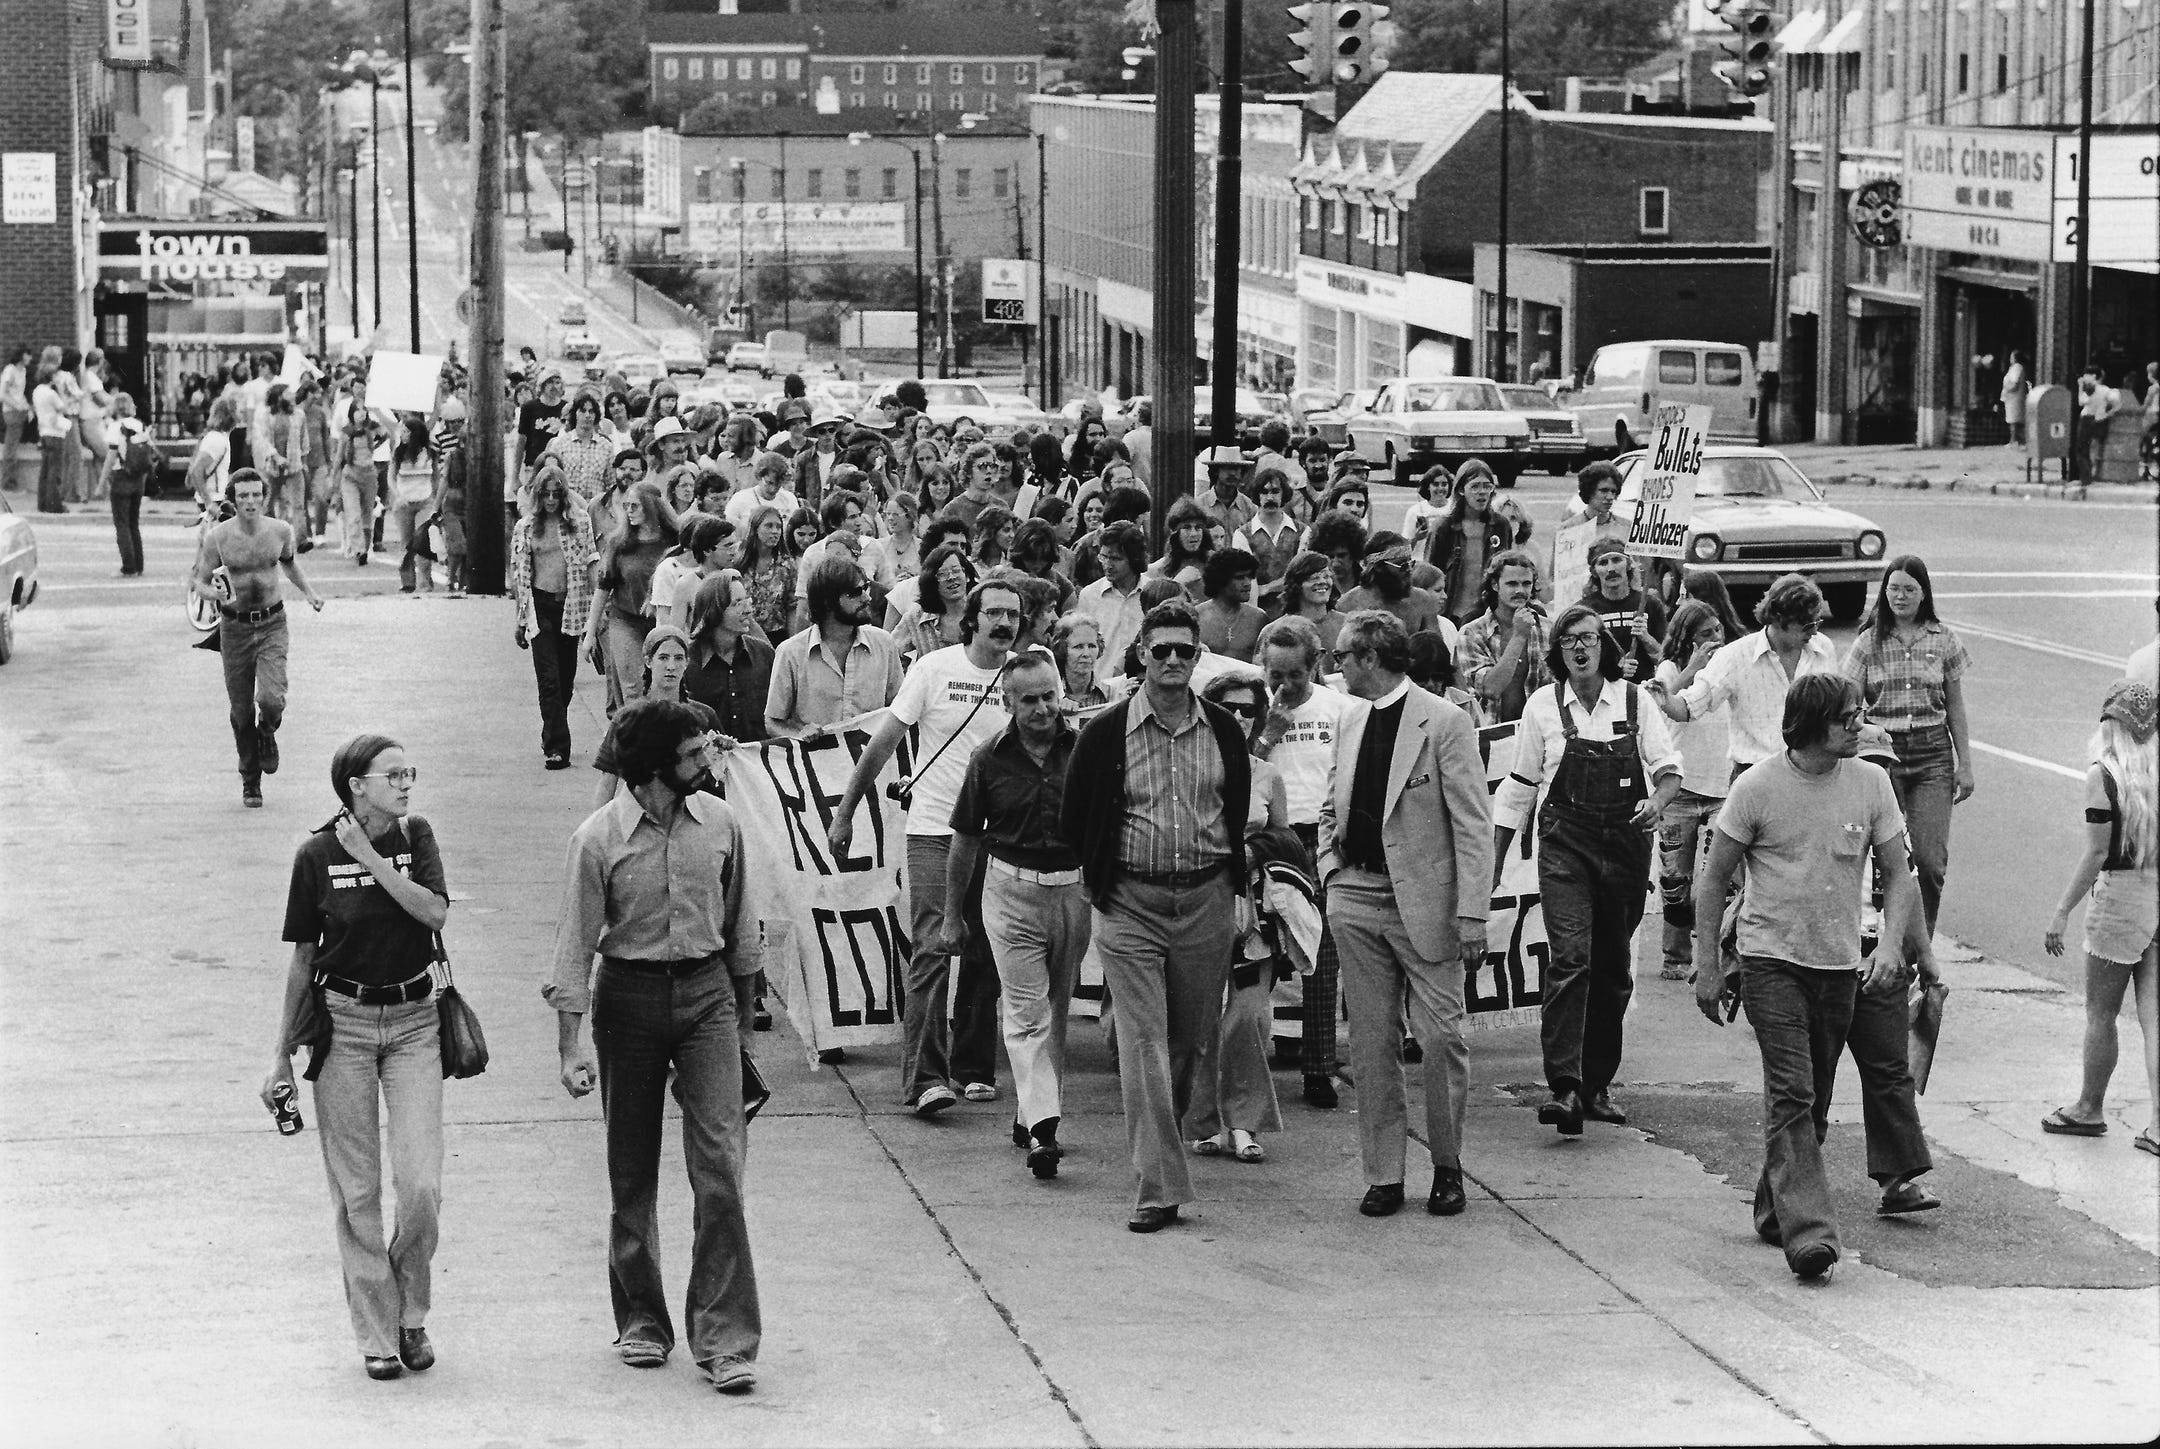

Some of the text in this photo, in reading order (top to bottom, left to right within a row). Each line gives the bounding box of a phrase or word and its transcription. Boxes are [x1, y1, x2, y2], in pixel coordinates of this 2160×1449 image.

[1911, 135, 1954, 175] kent
[1961, 138, 2045, 182] cinemas
[2070, 152, 2077, 181] 1
[12, 191, 44, 200] RENT
[136, 230, 251, 257] town
[2066, 216, 2079, 245] 2
[140, 252, 287, 281] house
[1654, 426, 1703, 475] Bullets
[1628, 500, 1689, 547] Bulldozer
[948, 681, 983, 691] REMEMBER
[949, 693, 967, 702] MOVE
[984, 697, 1000, 706] GYM
[1286, 734, 1297, 742] THE
[1300, 733, 1314, 741] GYM
[1299, 721, 1314, 730] KENT
